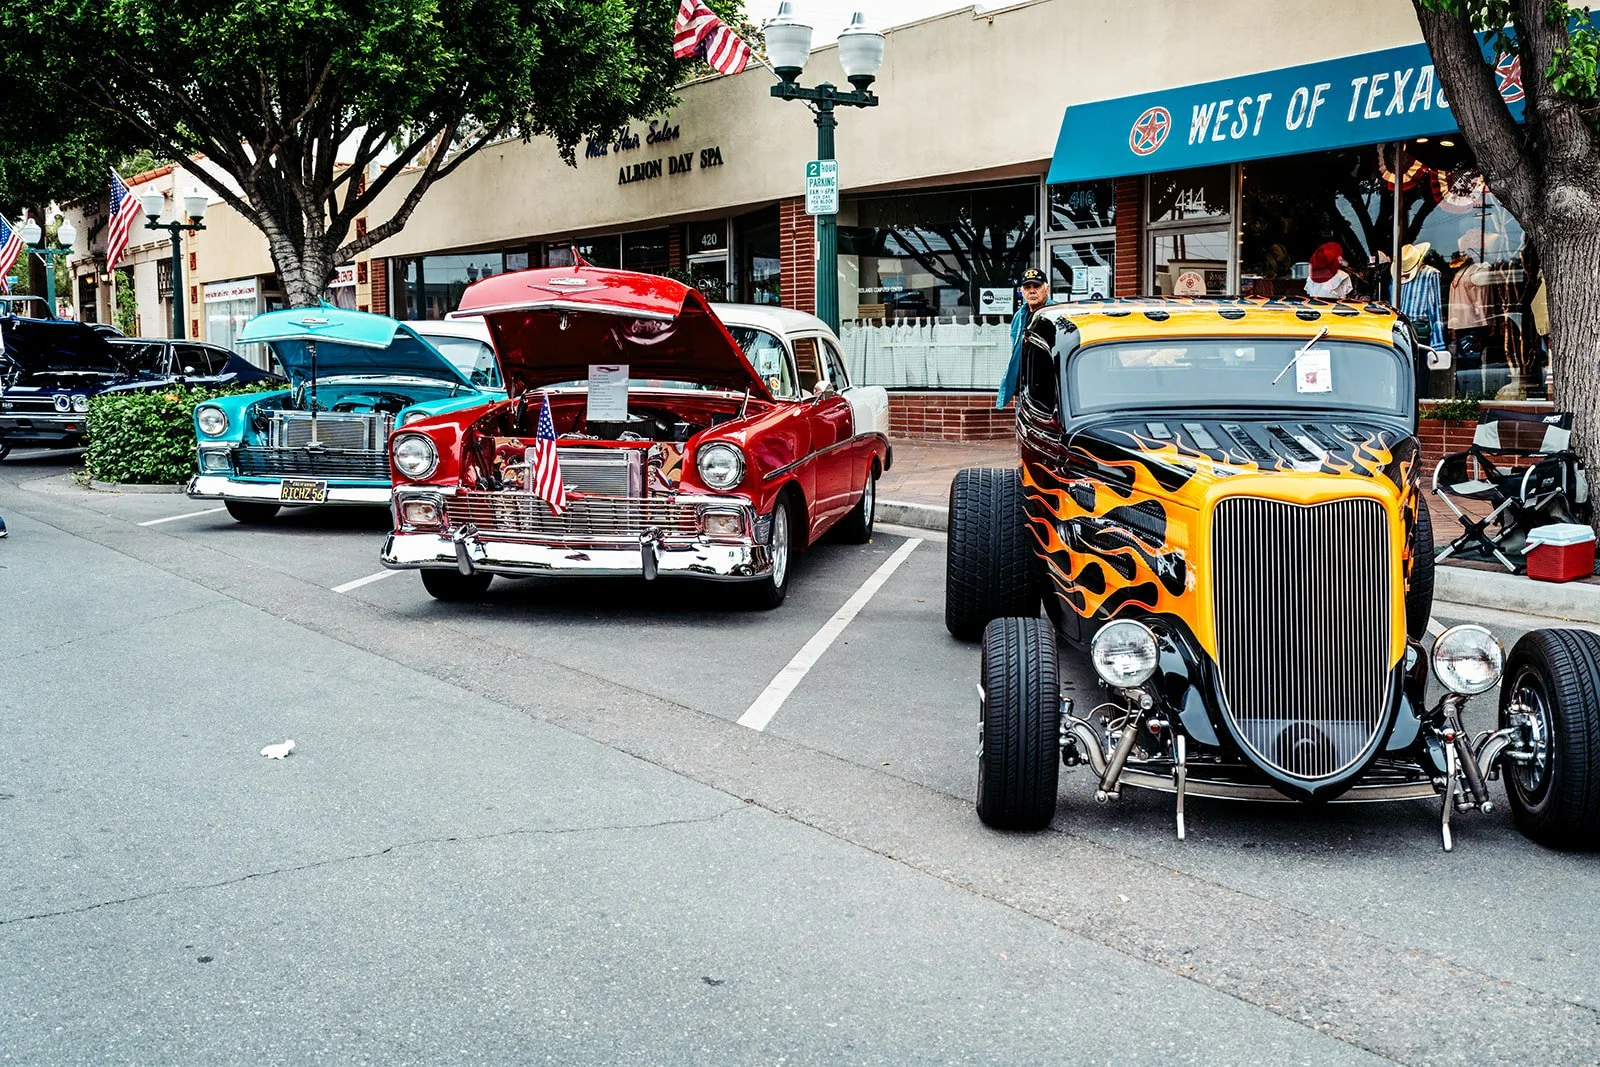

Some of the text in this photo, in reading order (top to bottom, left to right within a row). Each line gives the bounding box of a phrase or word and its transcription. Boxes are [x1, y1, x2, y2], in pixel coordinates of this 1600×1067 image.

[1188, 93, 1272, 145] WEST
[1286, 83, 1331, 131] OF
[613, 125, 640, 152] Hair
[646, 120, 680, 145] Salon
[618, 146, 724, 185] ALBION DAY SPA
[810, 163, 836, 176] 2 HOUR
[809, 177, 835, 187] PARKING
[1069, 189, 1095, 210] 416
[1175, 187, 1206, 212] 414
[701, 233, 717, 246] 420
[282, 487, 324, 501] RICHZ 56
